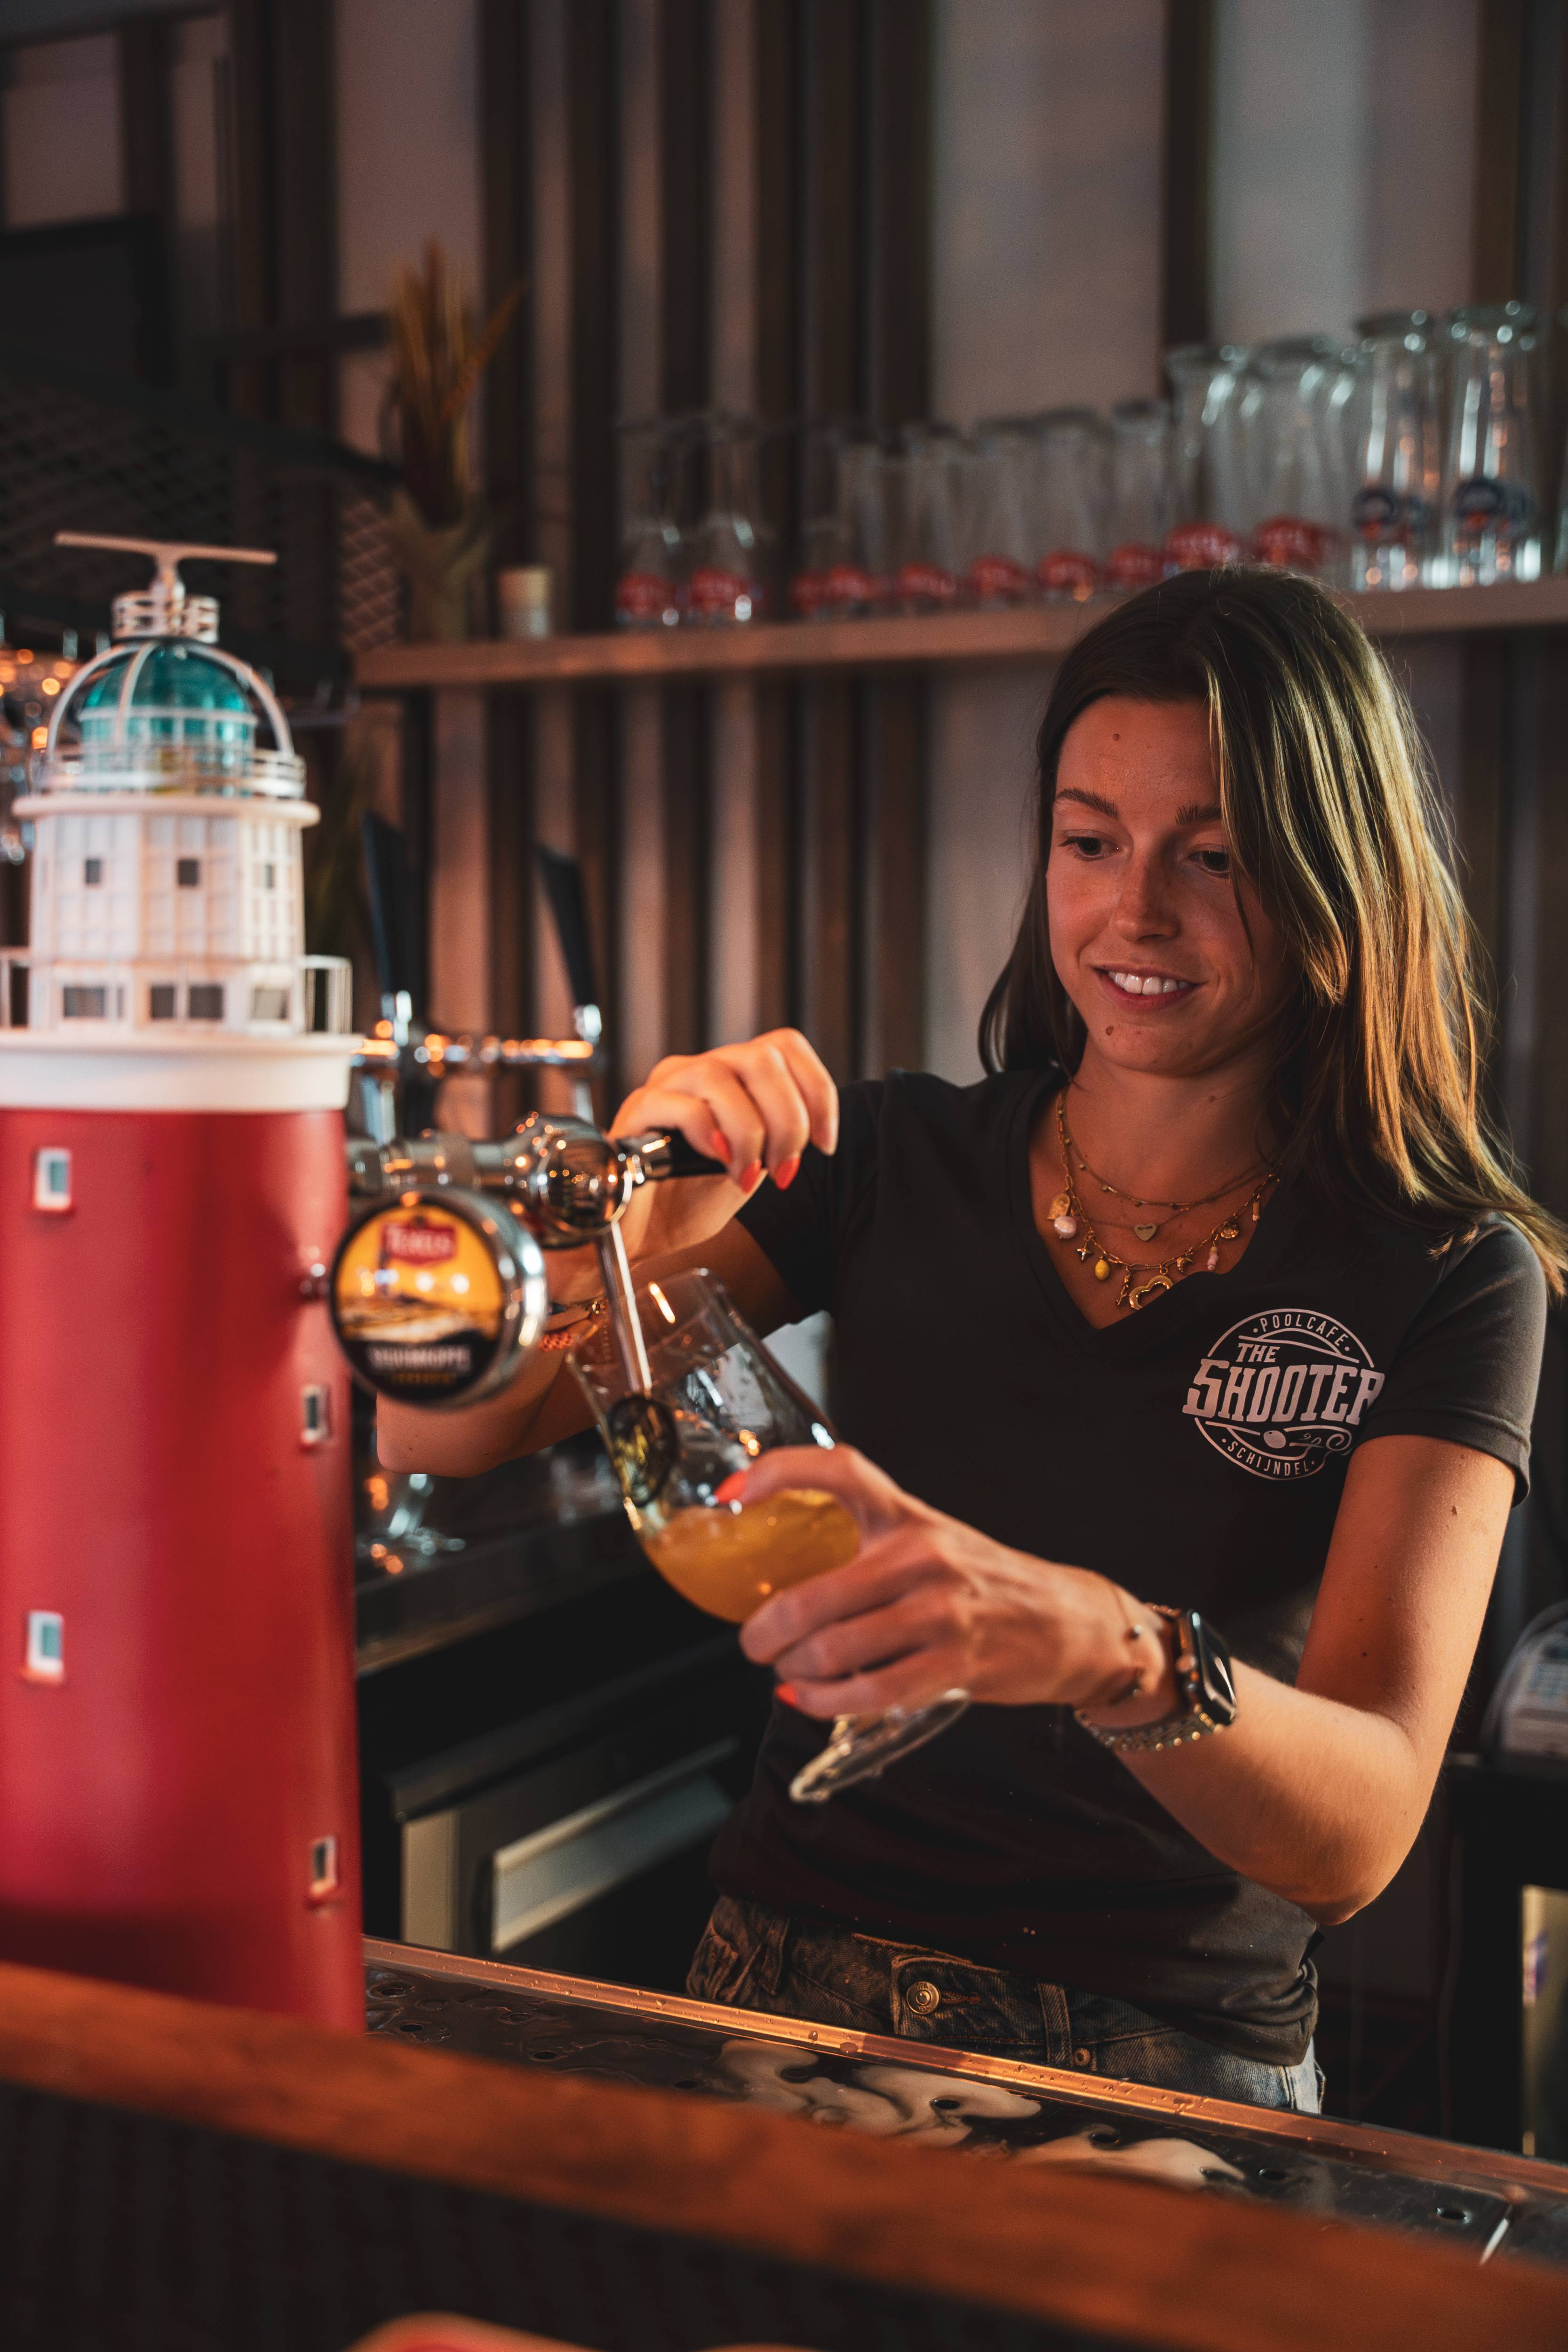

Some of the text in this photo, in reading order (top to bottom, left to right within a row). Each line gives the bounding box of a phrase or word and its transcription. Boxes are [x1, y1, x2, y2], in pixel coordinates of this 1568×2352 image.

[1260, 1313, 1348, 1347] POOLCAFE
[1236, 1342, 1281, 1363] THE
[1182, 1358, 1385, 1425] SHOOTER
[1227, 1441, 1309, 1476] SCHIJNDEL
